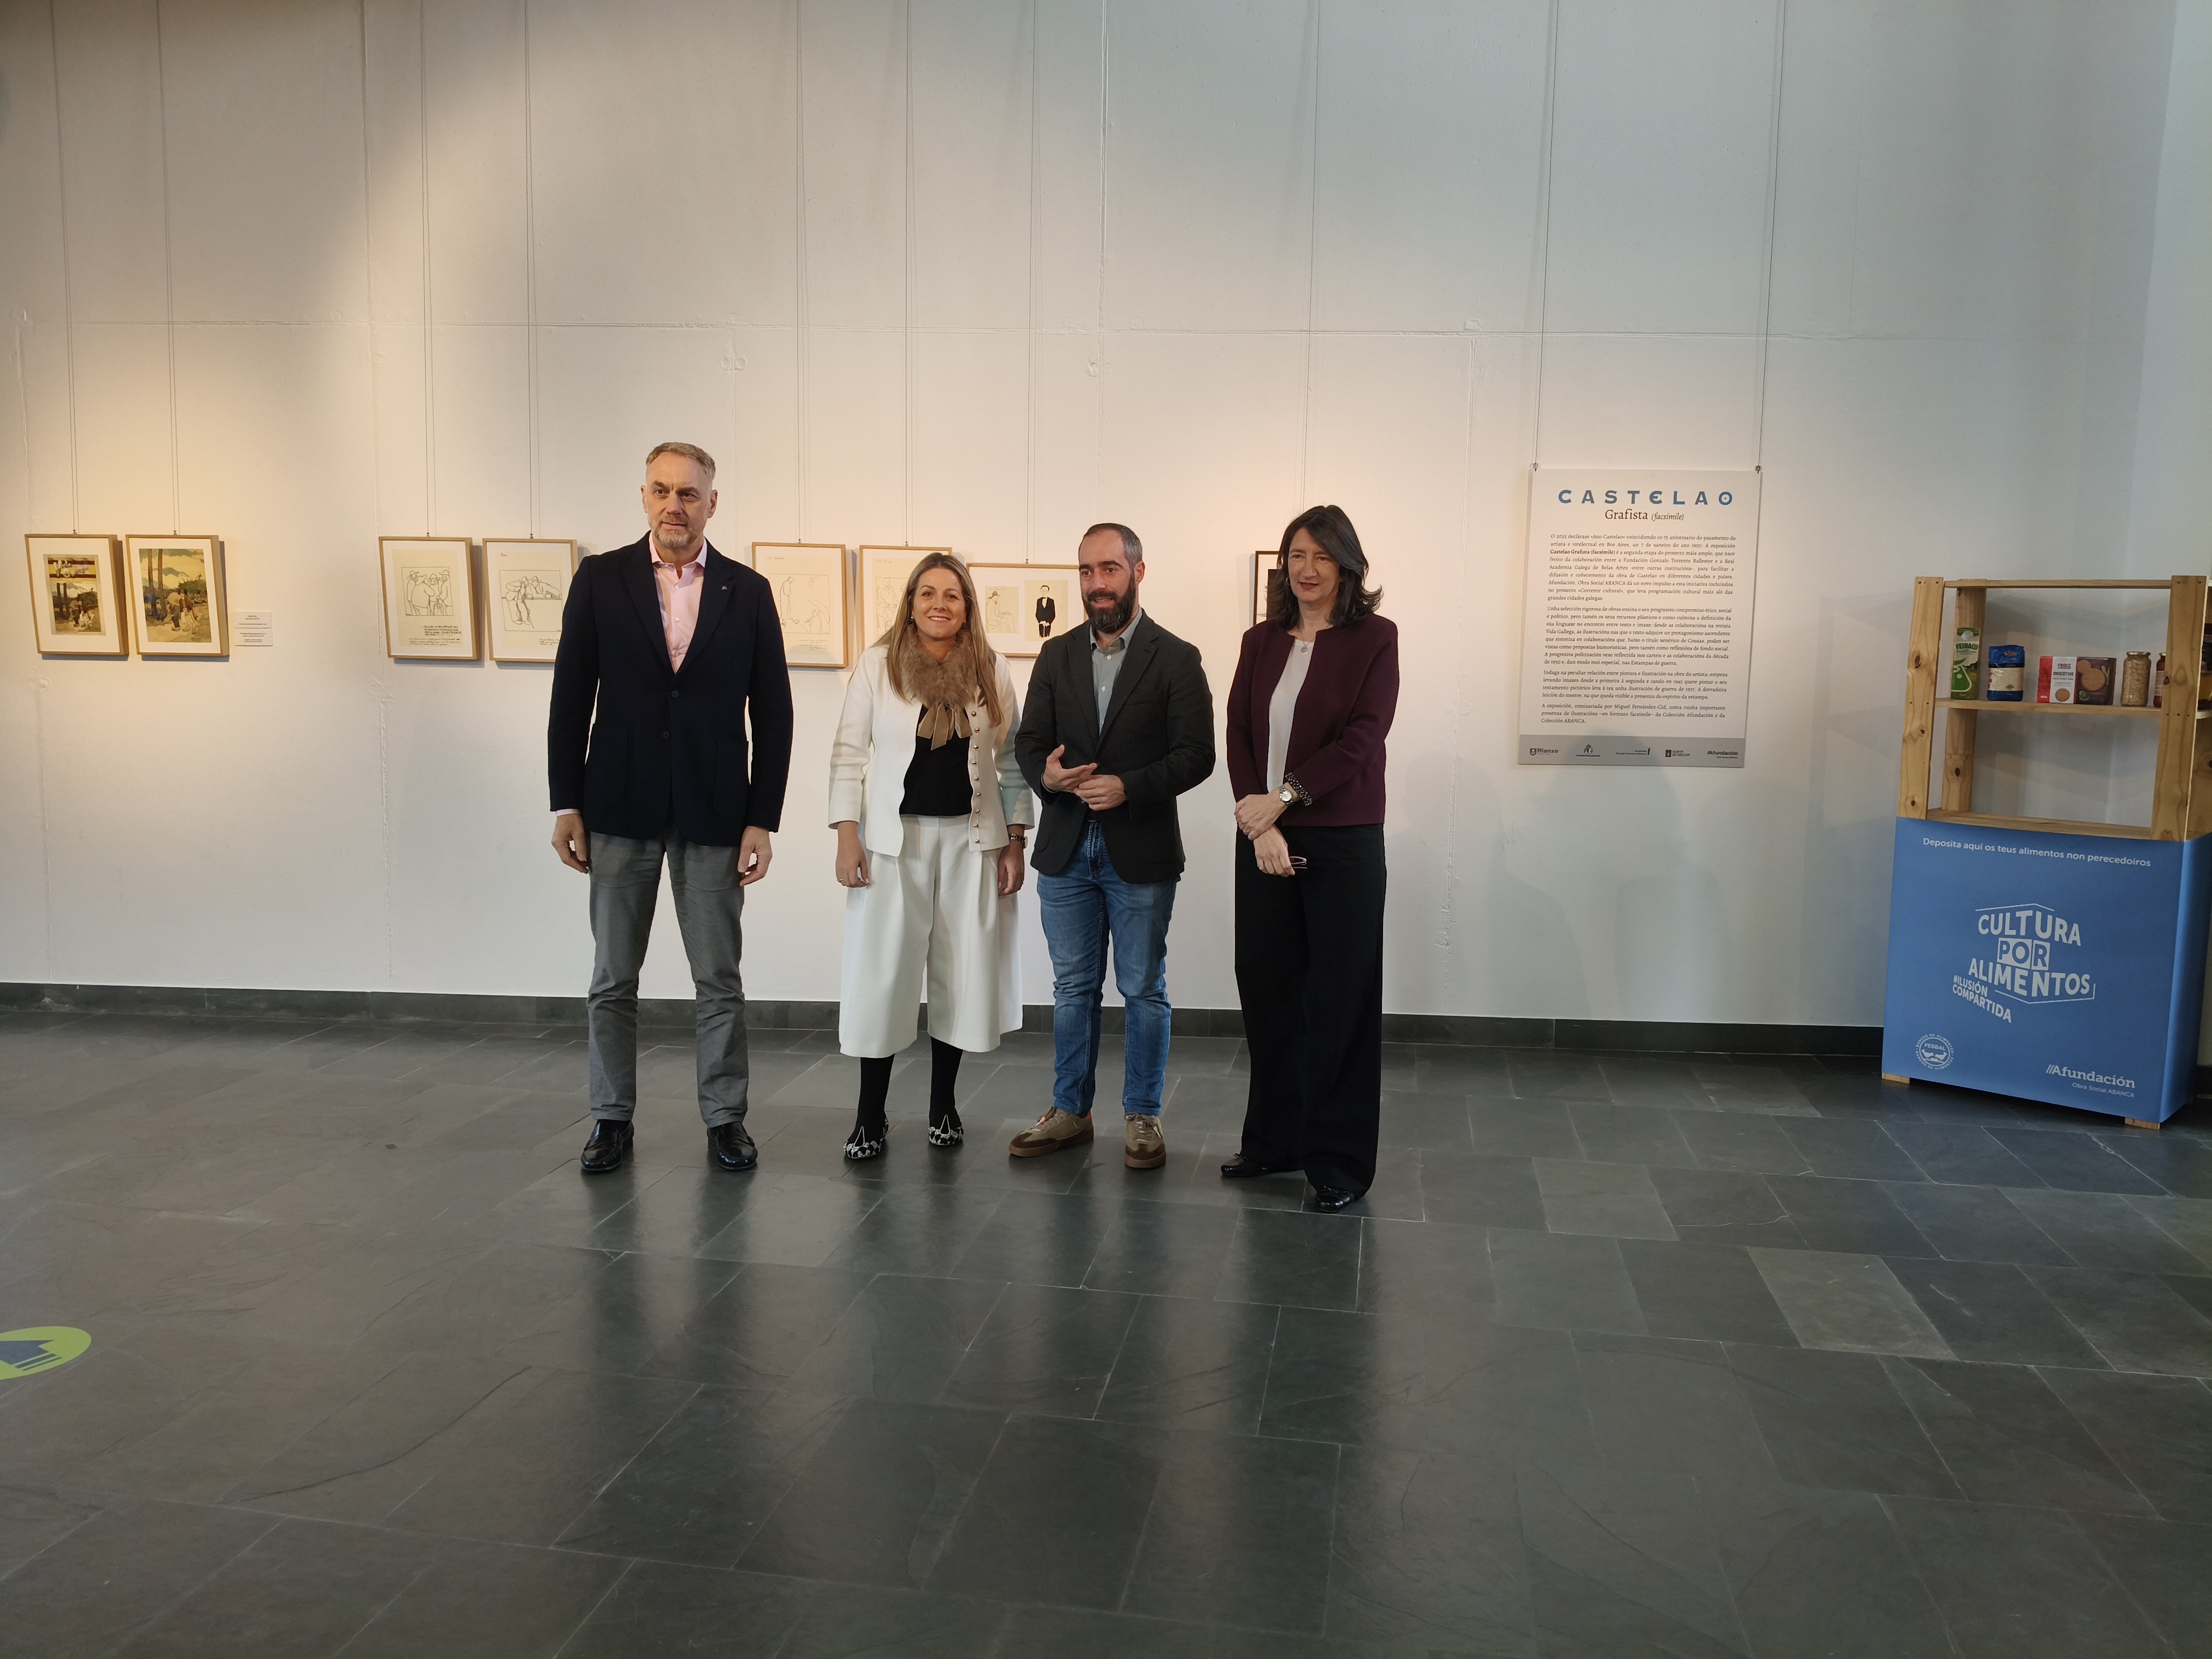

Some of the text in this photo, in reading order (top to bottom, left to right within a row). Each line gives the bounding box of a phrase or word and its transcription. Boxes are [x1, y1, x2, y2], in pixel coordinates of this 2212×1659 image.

[1559, 490, 1732, 505] CASTELAO
[1605, 509, 1684, 521] Grafista (facsímile)
[1924, 838, 1961, 848] Deposita
[2019, 847, 2064, 858] alimentos
[2088, 855, 2150, 866] perecedoiros
[1978, 910, 2081, 946] CULTURA
[1999, 940, 2049, 968] POR
[1953, 974, 1988, 997] #ILUSIÓN
[1968, 957, 2090, 997] ALIMENTOS
[1952, 984, 2012, 1023] COMPARTIDA
[2108, 1089, 2134, 1097] ABANCA
